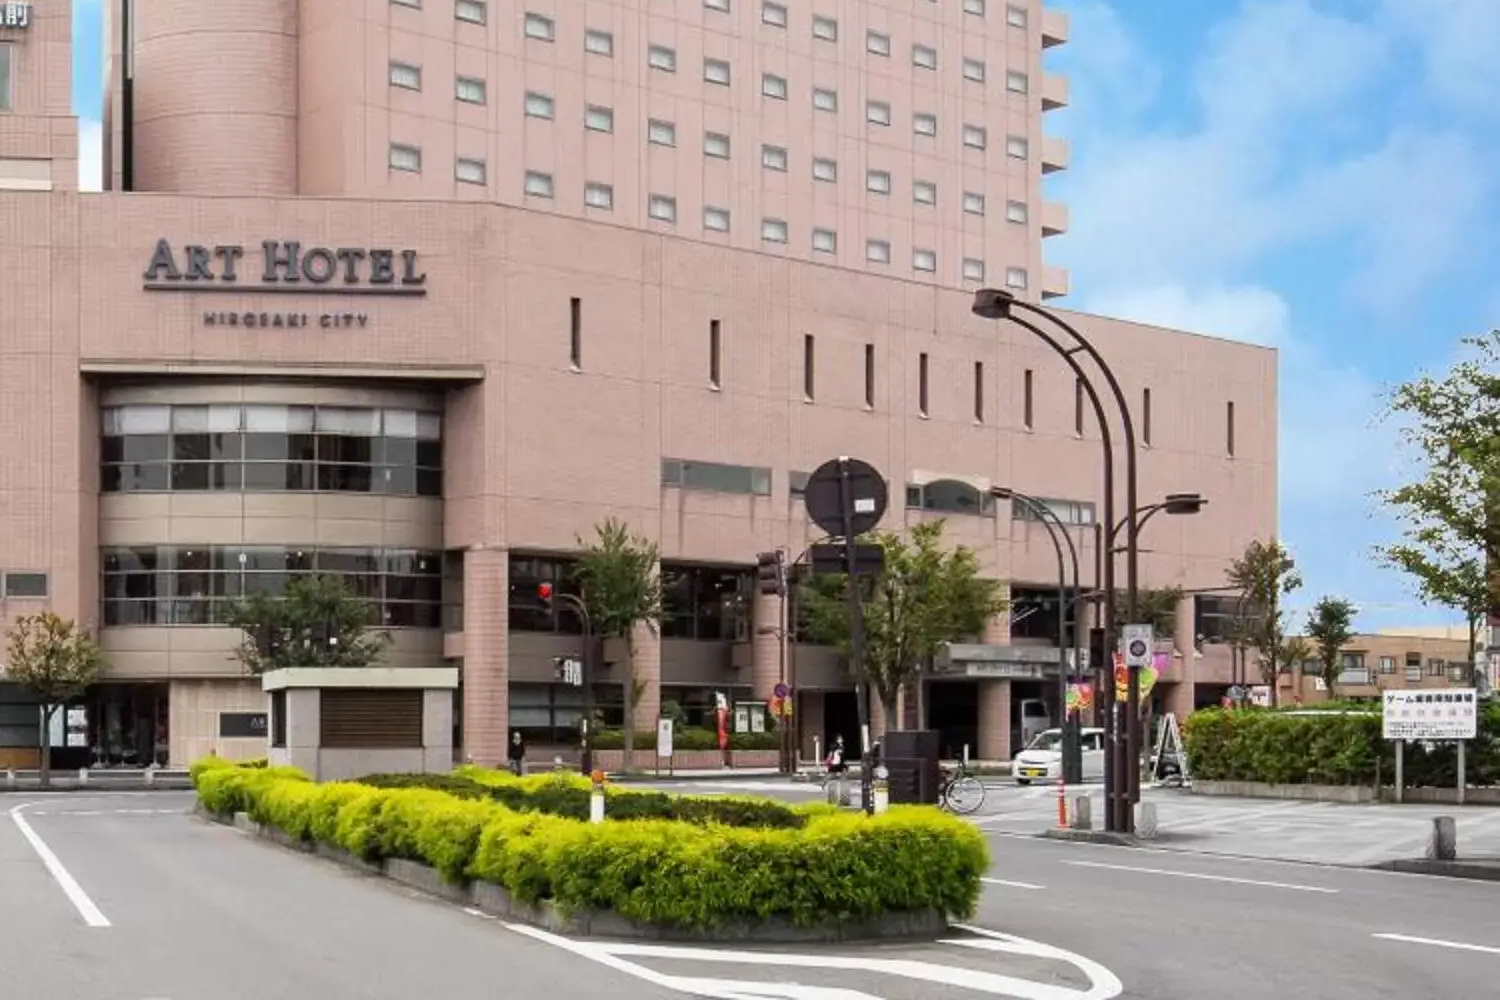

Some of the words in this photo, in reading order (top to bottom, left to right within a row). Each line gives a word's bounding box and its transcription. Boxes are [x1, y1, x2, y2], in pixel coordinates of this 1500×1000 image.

[143, 238, 243, 281] ART
[262, 240, 426, 284] HOTEL
[203, 311, 308, 328] HIROSAKI
[319, 313, 368, 328] CITY
